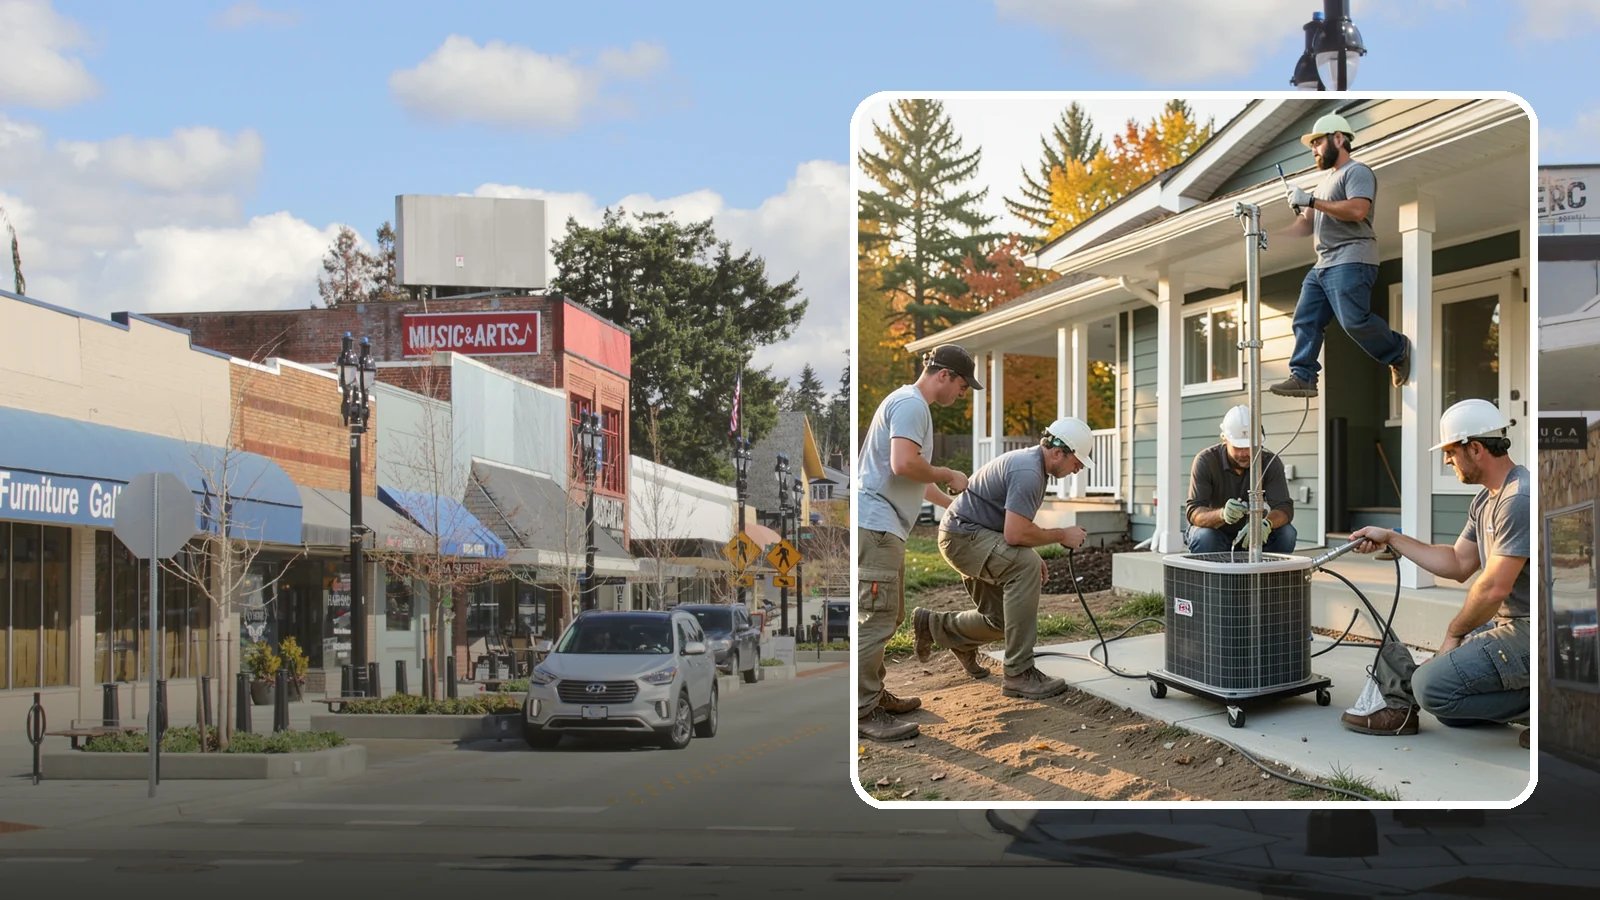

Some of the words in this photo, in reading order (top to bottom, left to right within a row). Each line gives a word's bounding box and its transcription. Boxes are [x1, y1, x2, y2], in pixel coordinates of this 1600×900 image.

[409, 323, 519, 348] MUSIC&ARTS
[1540, 427, 1577, 437] UGA
[0, 471, 79, 515] Furniture
[89, 482, 121, 519] Gal
[454, 563, 479, 574] SUSHI
